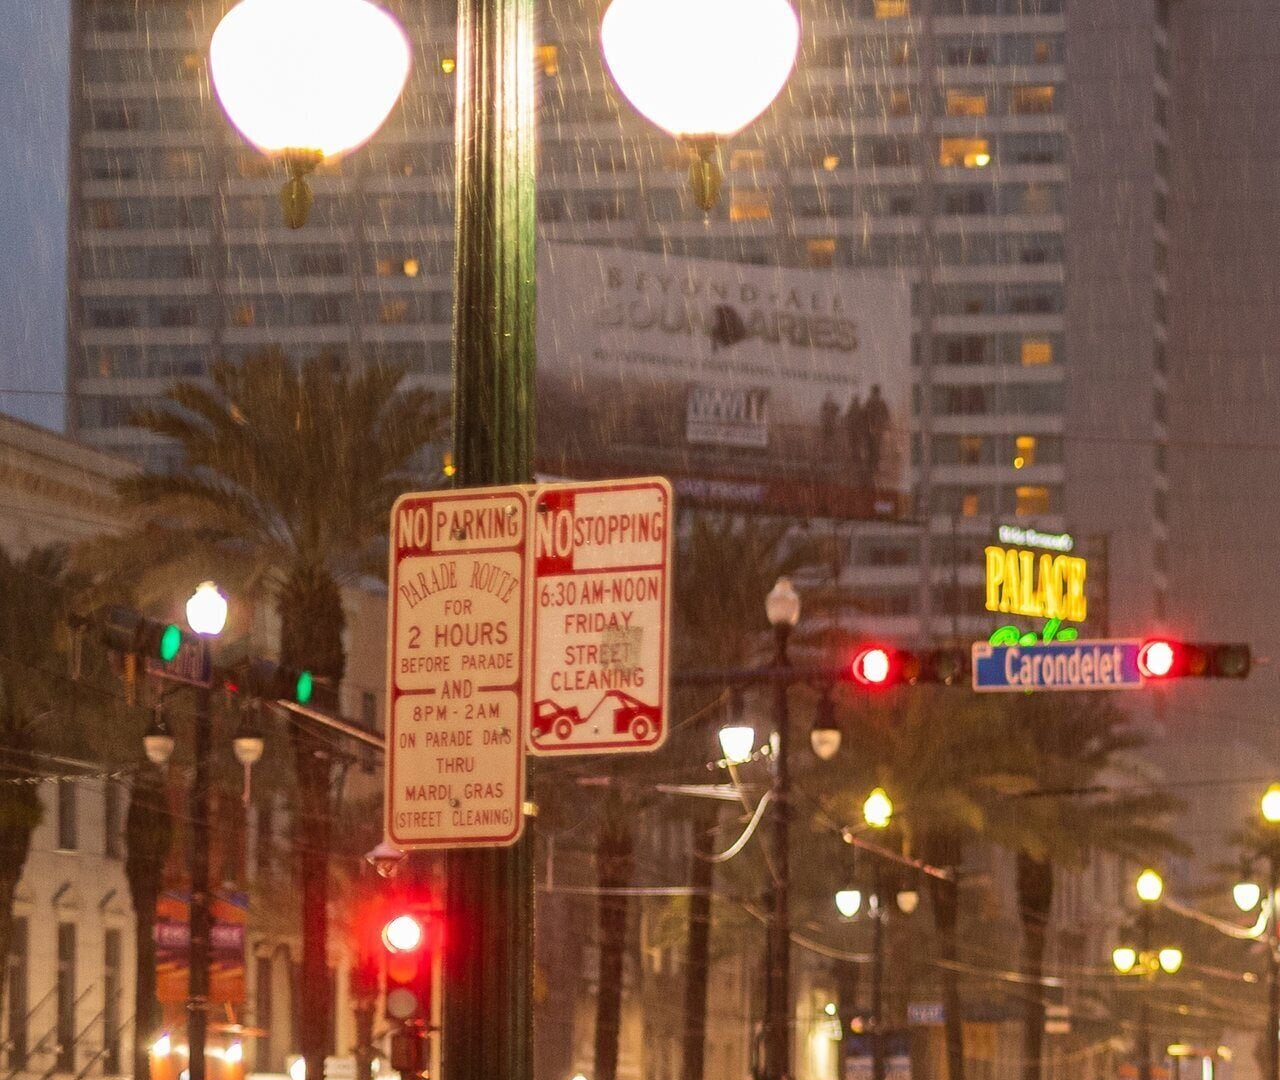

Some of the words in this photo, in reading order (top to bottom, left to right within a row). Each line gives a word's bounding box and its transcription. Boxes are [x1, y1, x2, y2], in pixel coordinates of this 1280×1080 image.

[594, 299, 860, 352] BOUNARIES
[400, 506, 430, 548] NO
[436, 505, 519, 542] PARKING
[535, 508, 572, 559] NO
[573, 510, 662, 547] STOPPING
[399, 559, 458, 610] PARADE
[470, 559, 520, 605] ROUTE
[540, 582, 577, 608] 6:30
[985, 546, 1087, 622] PALACE
[444, 599, 473, 616] FOR
[564, 611, 633, 634] FRIDAY
[407, 626, 422, 650] 2
[434, 620, 508, 648] HOURS
[400, 656, 451, 675] BEFORE
[460, 653, 514, 672] PARADE
[565, 642, 631, 666] STREET
[1004, 647, 1122, 685] Carondelet
[440, 679, 473, 700] AND
[550, 668, 645, 693] CLEANING
[412, 705, 447, 723] 8PM
[464, 702, 501, 721] 2AM
[400, 732, 416, 750] ON
[425, 730, 473, 749] PARADE
[482, 728, 513, 747] DAYS
[436, 757, 474, 774] THRU
[405, 785, 453, 802] MARDI
[464, 783, 504, 800] GRAS
[396, 809, 442, 831] (STREET
[452, 807, 513, 828] CLEANING)
